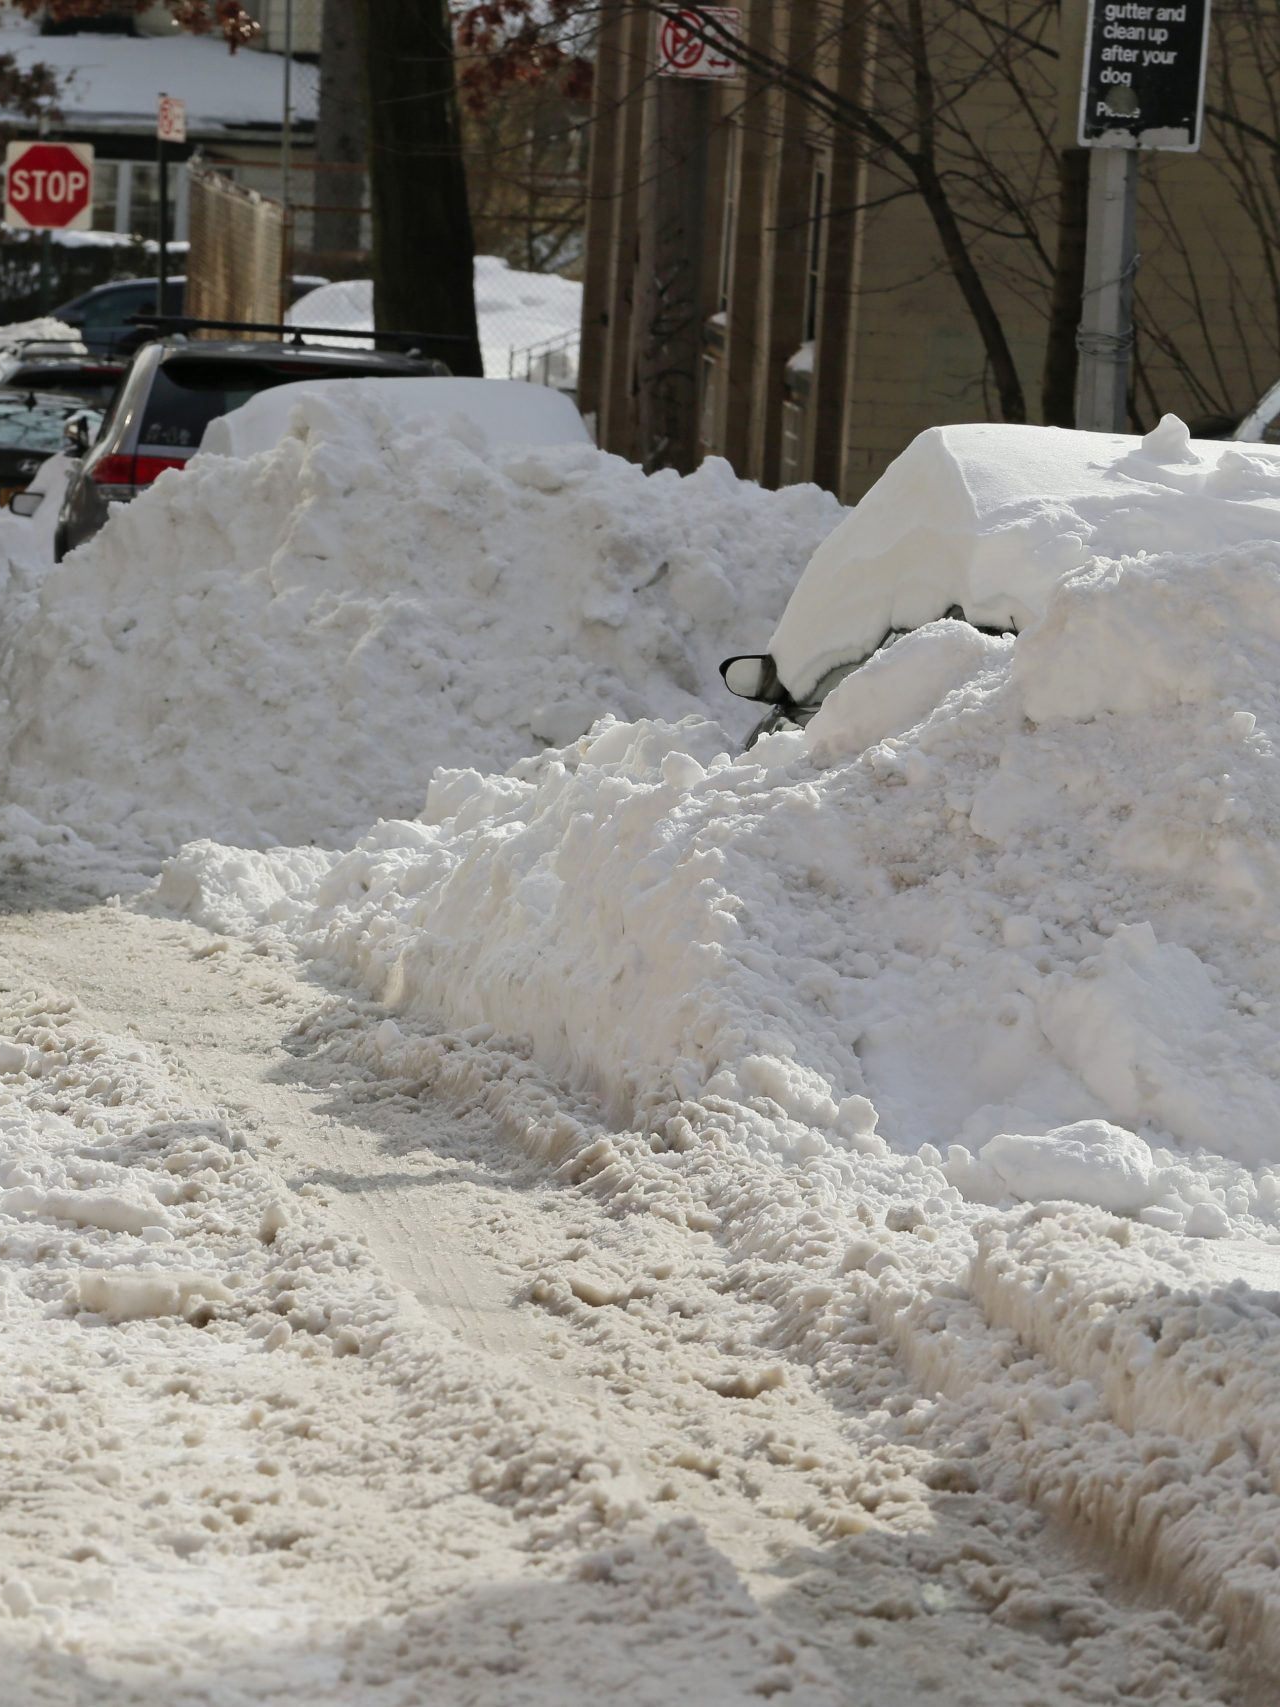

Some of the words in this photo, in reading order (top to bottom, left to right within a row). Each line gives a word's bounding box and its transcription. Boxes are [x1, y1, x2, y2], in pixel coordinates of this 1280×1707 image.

[1104, 3, 1154, 21] gutter
[1156, 5, 1186, 22] and
[1103, 22, 1145, 40] clean
[1148, 27, 1169, 45] up
[1101, 45, 1139, 62] after
[1142, 50, 1177, 66] your
[1100, 67, 1131, 87] dog
[11, 169, 86, 202] STOP
